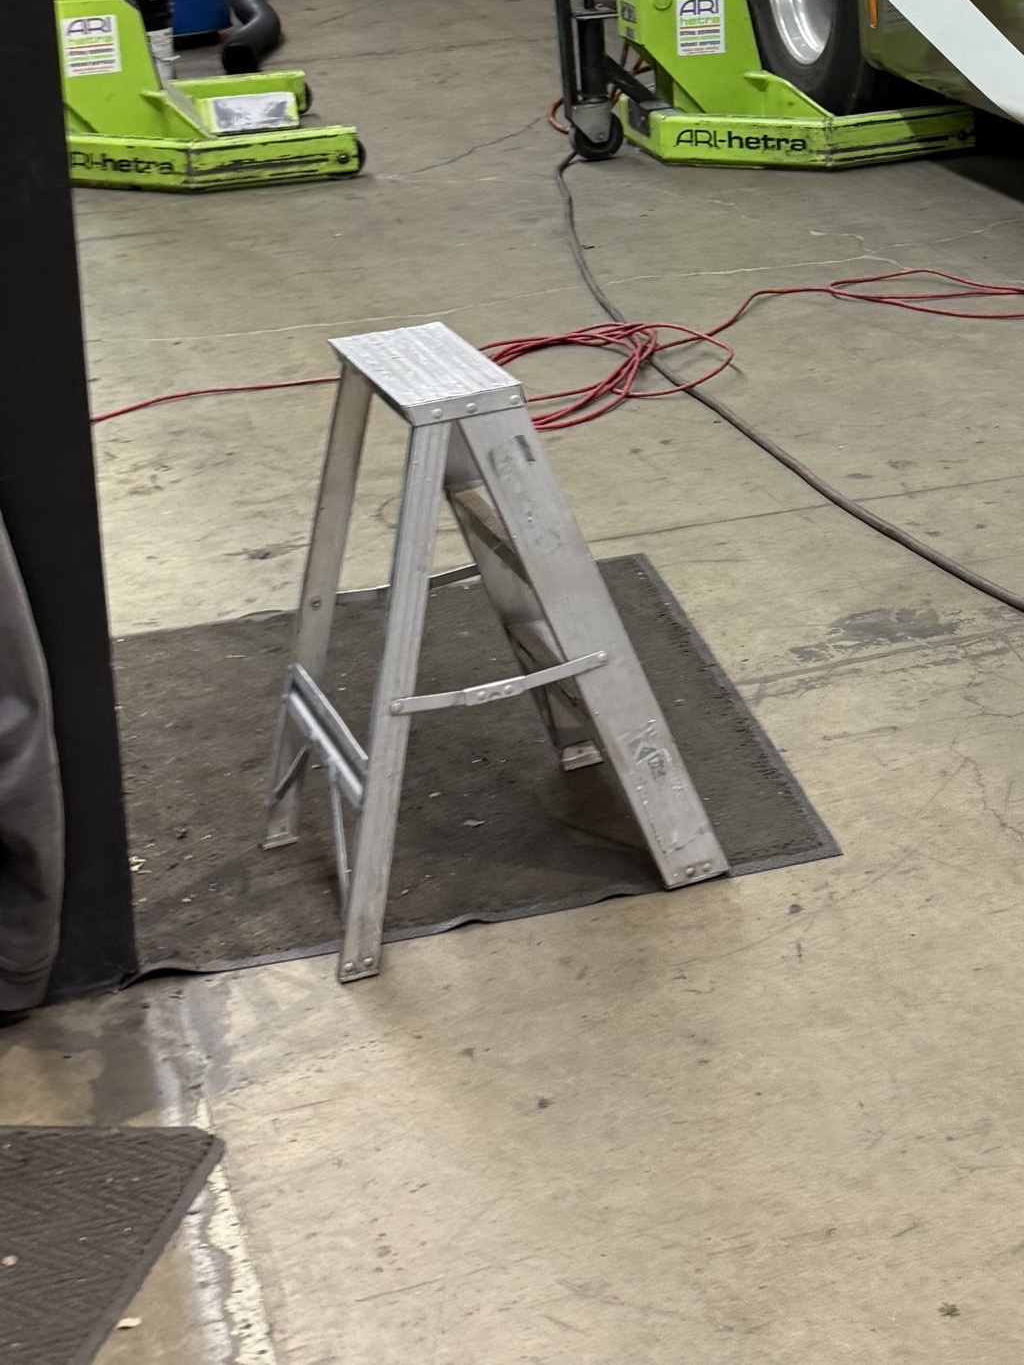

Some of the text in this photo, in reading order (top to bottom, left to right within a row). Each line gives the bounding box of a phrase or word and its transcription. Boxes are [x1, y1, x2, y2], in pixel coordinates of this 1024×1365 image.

[66, 17, 112, 36] ARI
[674, 129, 807, 151] ARI-hetra
[70, 151, 174, 174] RI-hetra
